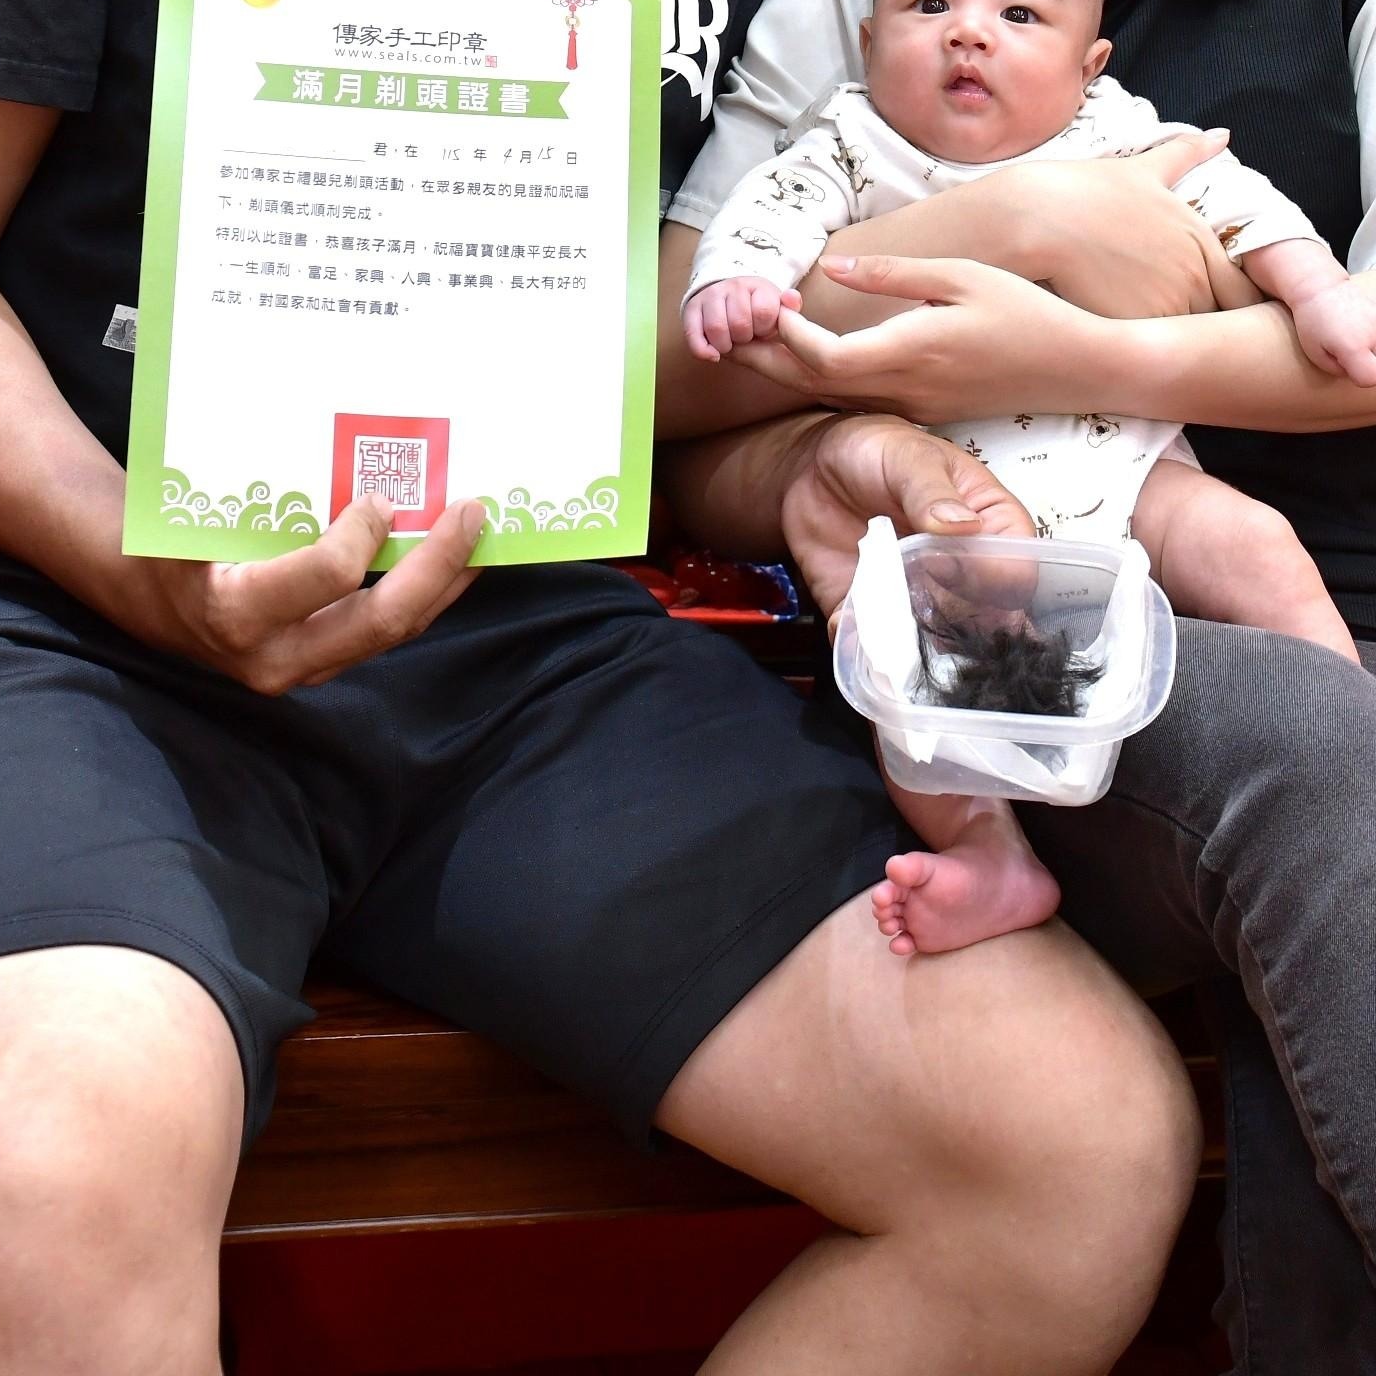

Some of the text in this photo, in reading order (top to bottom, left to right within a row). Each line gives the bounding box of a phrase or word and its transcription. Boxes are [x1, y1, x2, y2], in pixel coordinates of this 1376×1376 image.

[332, 23, 488, 54] 傳家手工印章
[335, 48, 482, 66] www.seals.com.tw
[292, 69, 531, 114] 滿月剃頭證書
[473, 148, 488, 162] 年
[519, 150, 532, 164] 月
[566, 151, 577, 165] 日
